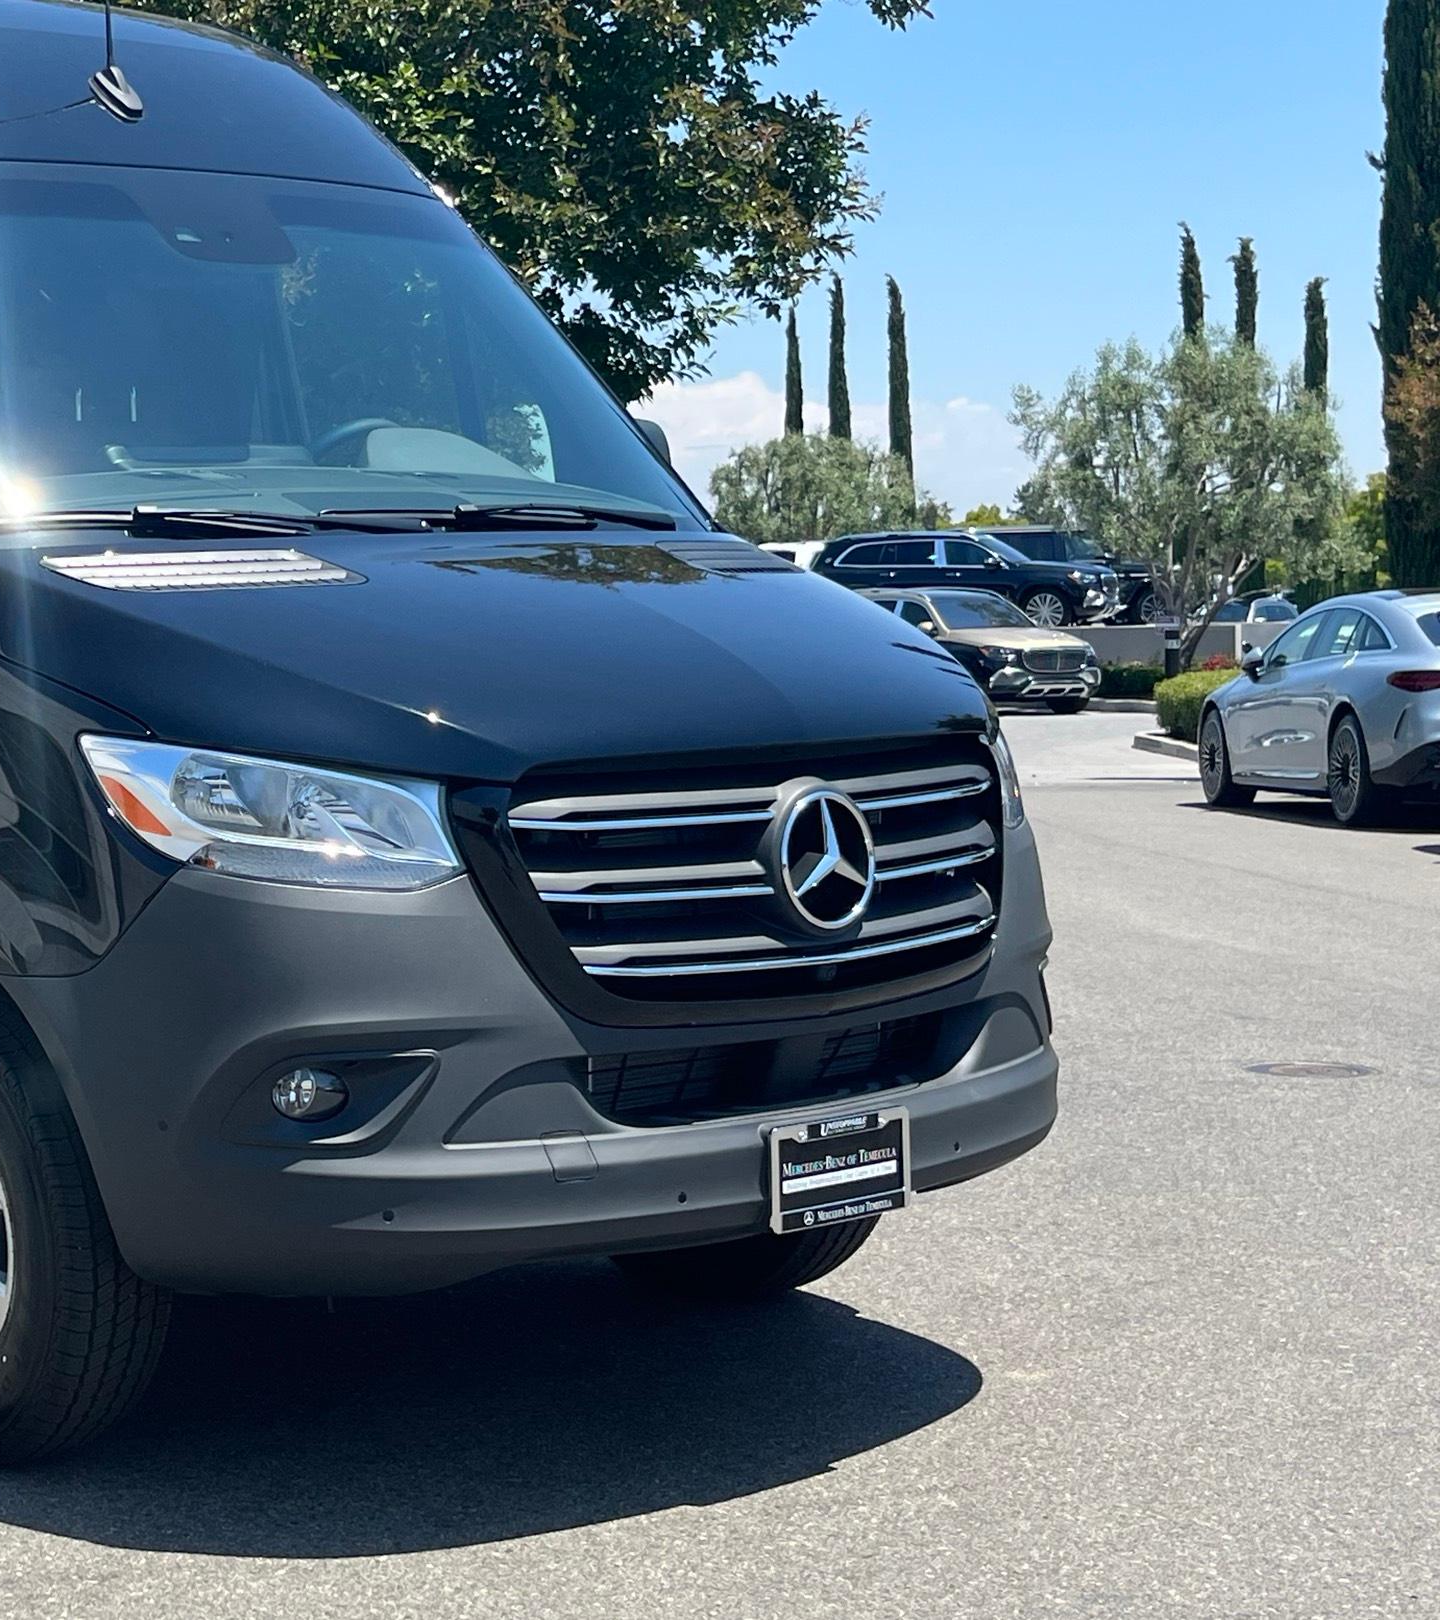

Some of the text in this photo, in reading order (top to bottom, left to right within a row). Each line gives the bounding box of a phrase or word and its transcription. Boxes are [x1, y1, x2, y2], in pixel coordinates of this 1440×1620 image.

[782, 1155, 846, 1178] MERCEDES-BENZ
[846, 1153, 858, 1166] OF
[858, 1146, 897, 1163] TEMECULA
